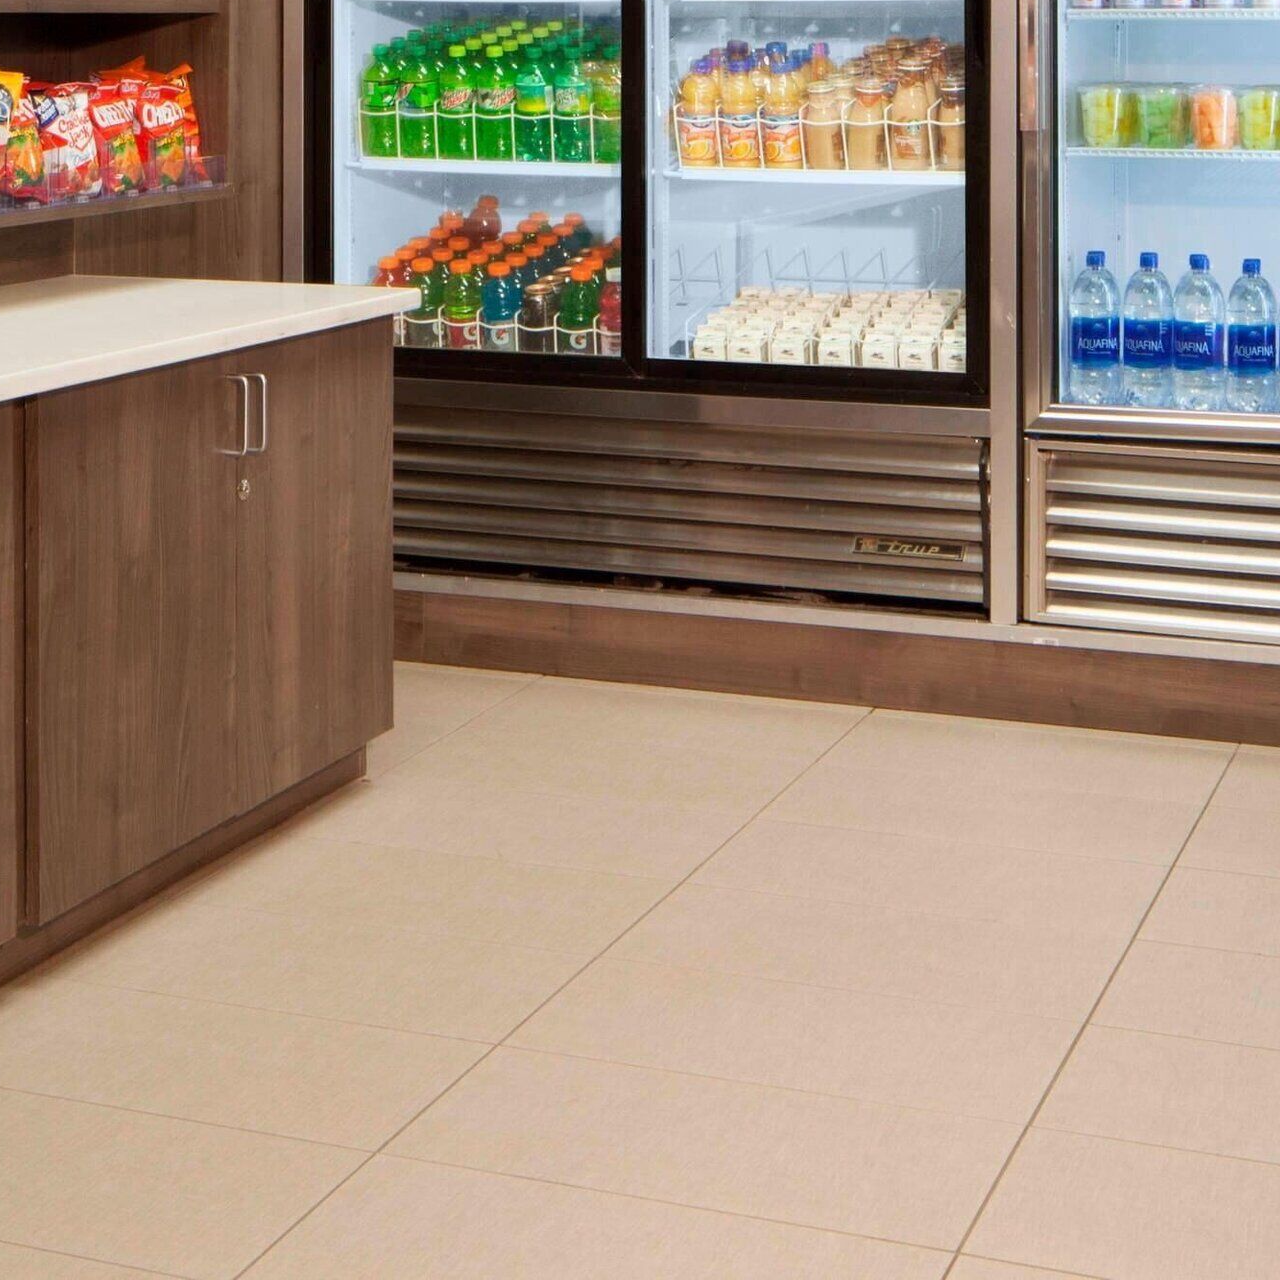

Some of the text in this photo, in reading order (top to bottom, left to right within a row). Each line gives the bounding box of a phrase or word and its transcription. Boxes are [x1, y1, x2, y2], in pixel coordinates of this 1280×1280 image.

[1078, 338, 1117, 350] AQUAFINA
[1125, 339, 1163, 352] QUAFINA
[1175, 340, 1210, 355] UAFINA
[1234, 345, 1275, 357] AQUAFINA
[883, 540, 946, 556] true
